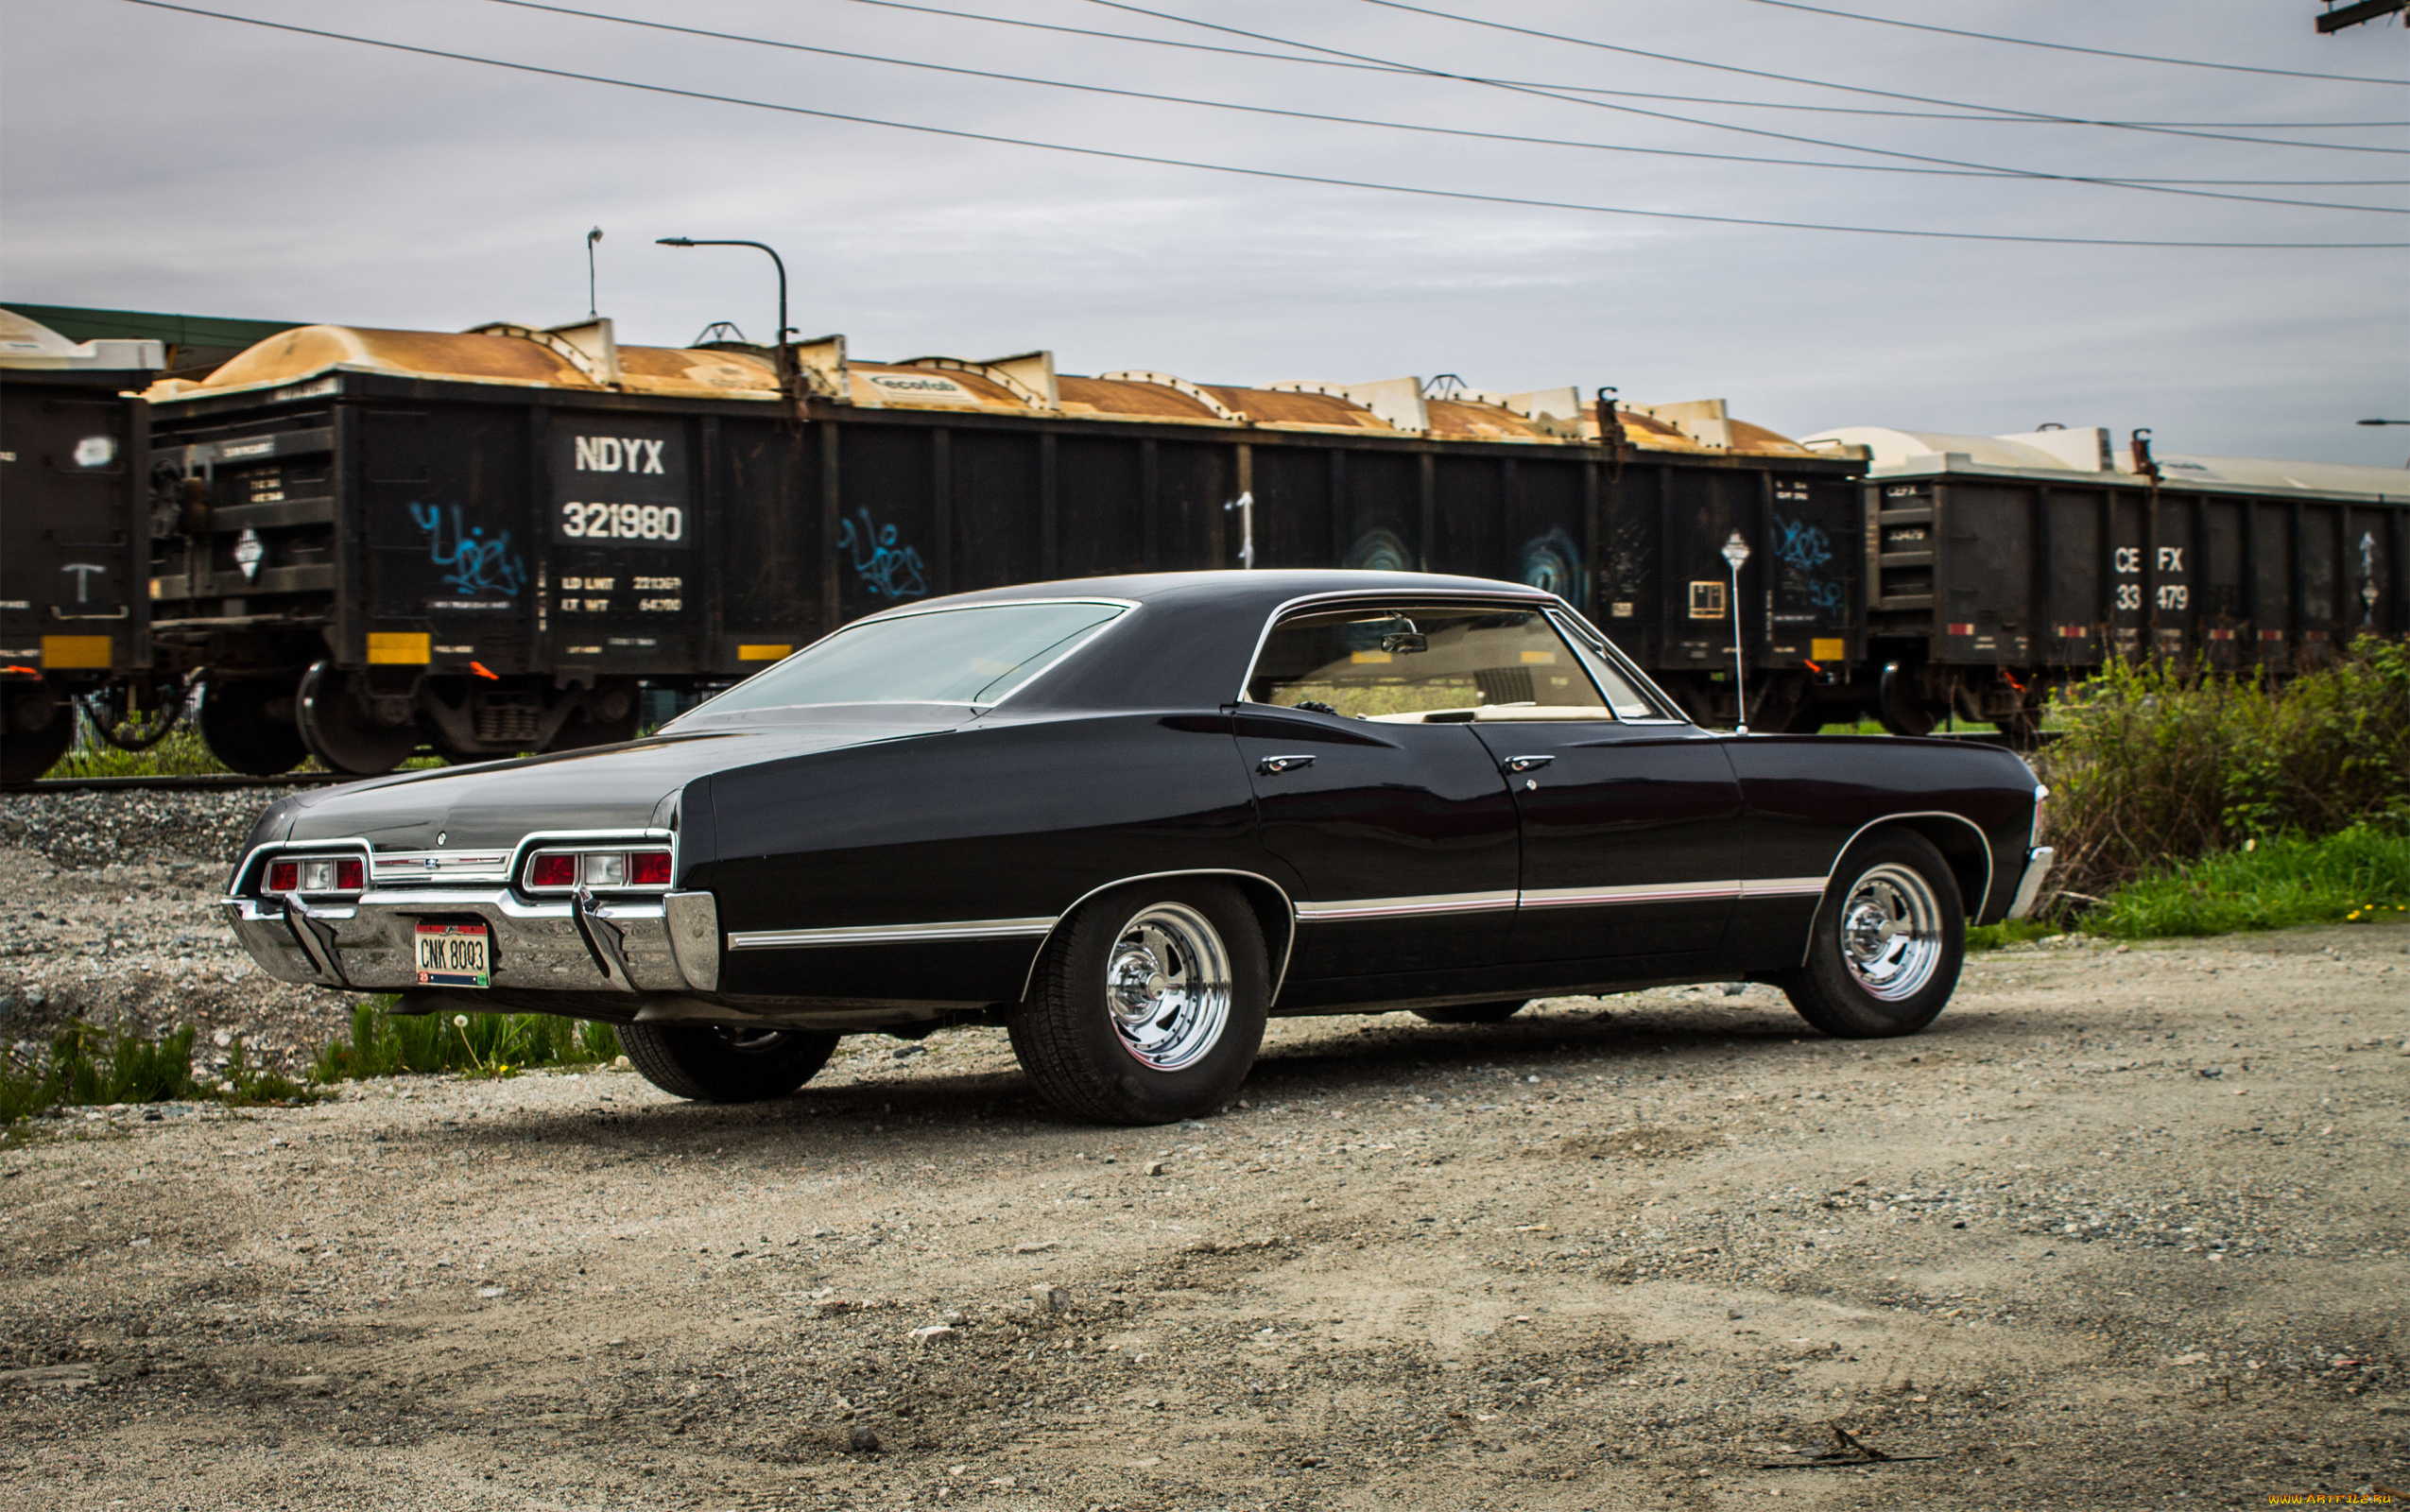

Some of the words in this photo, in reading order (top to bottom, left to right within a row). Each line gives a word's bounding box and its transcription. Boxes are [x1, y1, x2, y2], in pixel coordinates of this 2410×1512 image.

[575, 436, 664, 474] NDYX
[562, 502, 682, 541] 321980
[2115, 547, 2140, 573] CE
[2157, 547, 2183, 572] FX
[561, 577, 582, 590] LD
[584, 599, 610, 612] WT
[2116, 584, 2141, 610] 33
[2157, 584, 2188, 610] 479
[421, 938, 447, 969] CNK
[450, 939, 484, 971] 80Q3
